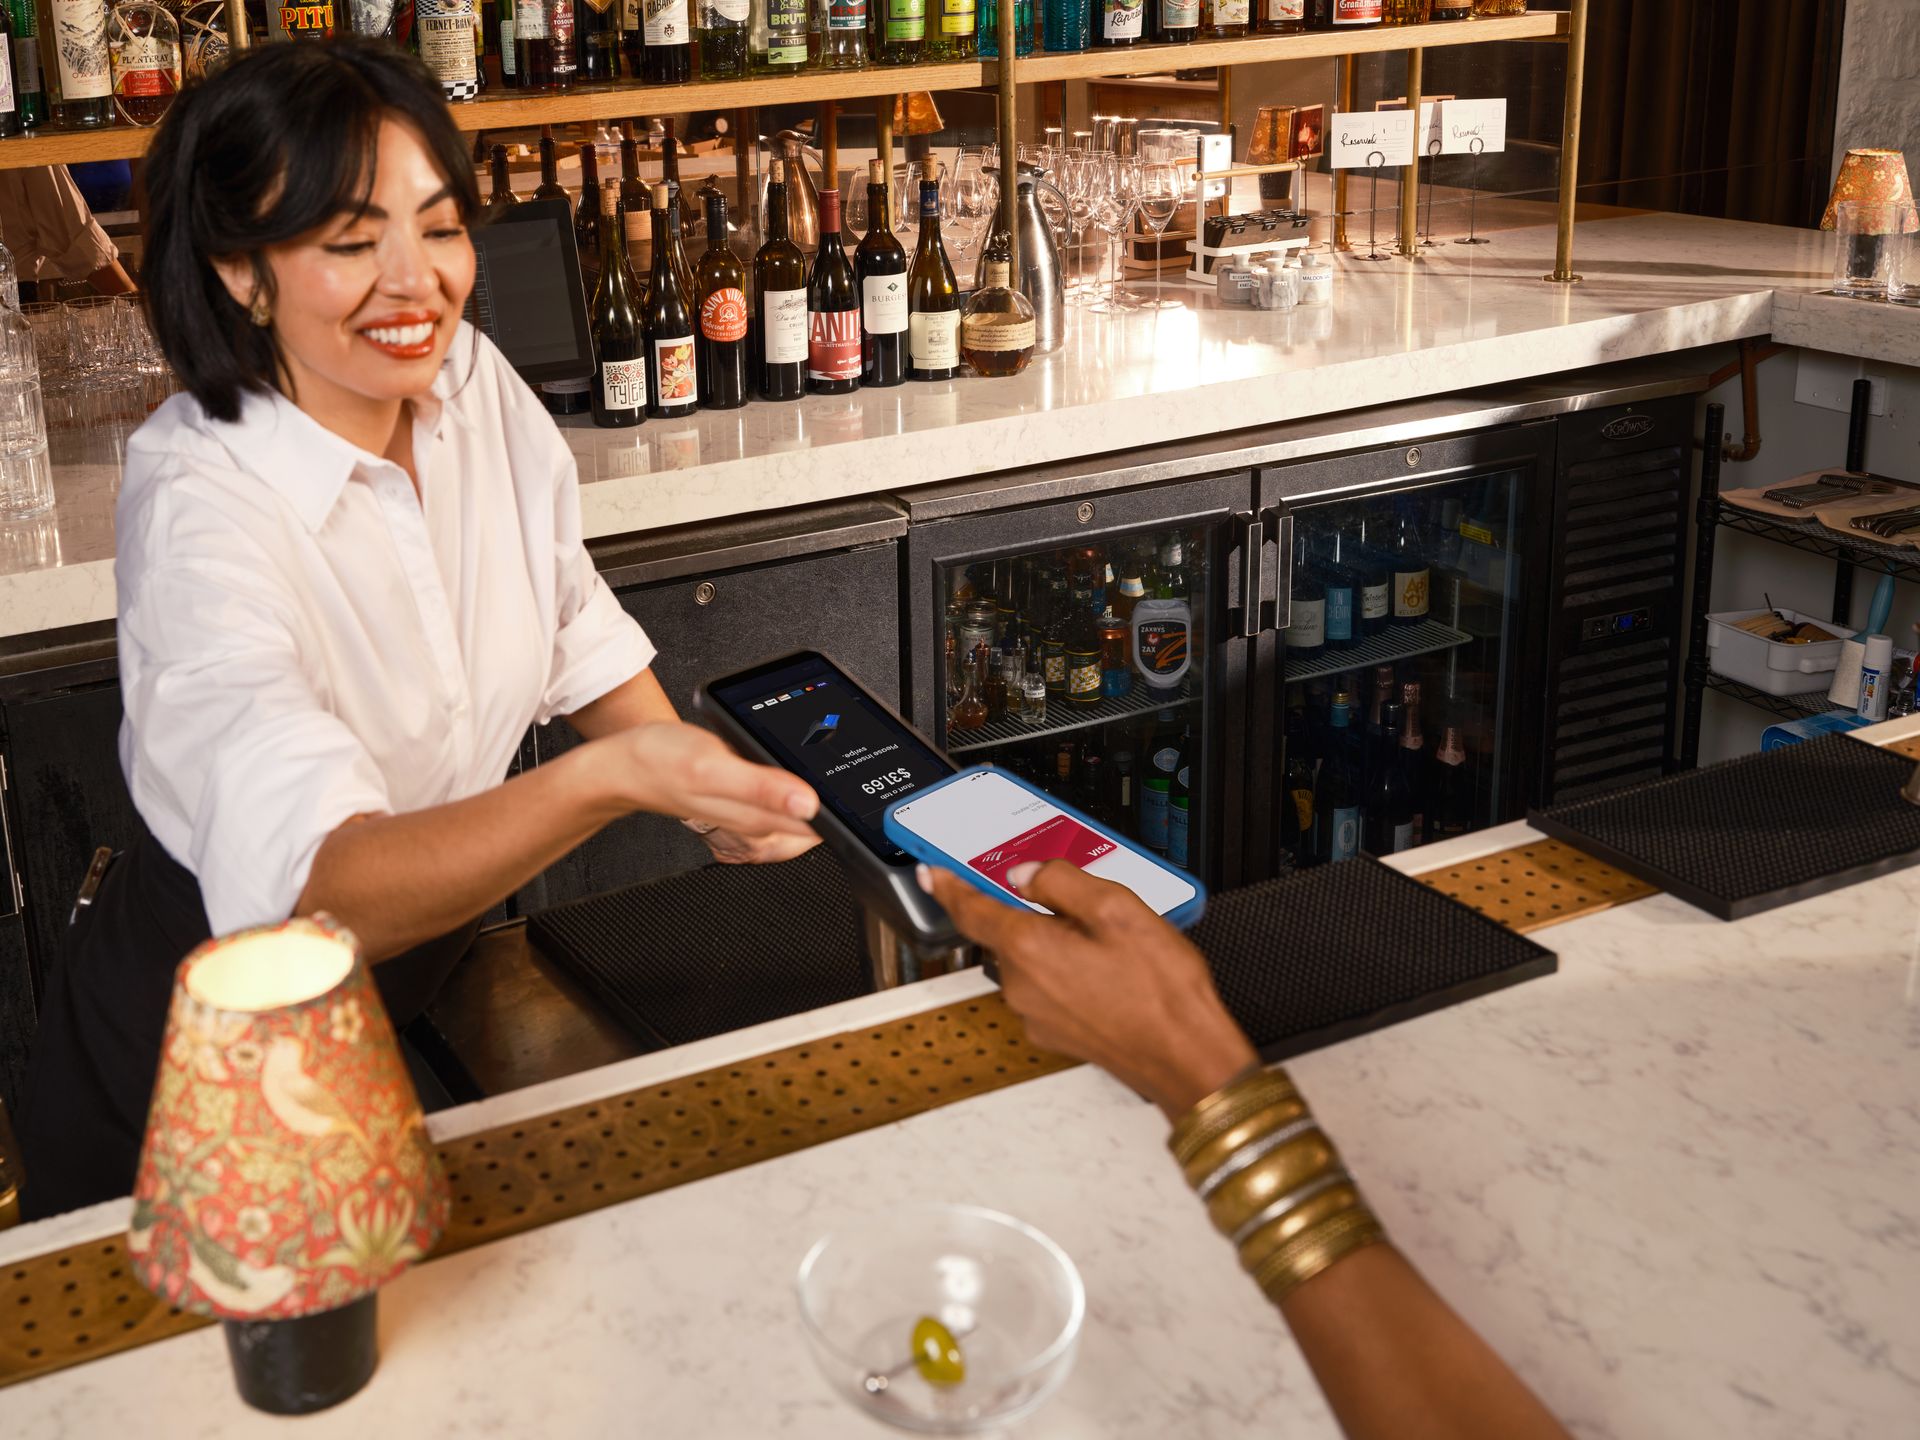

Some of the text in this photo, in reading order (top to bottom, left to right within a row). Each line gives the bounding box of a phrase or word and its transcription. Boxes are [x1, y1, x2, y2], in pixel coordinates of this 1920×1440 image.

[771, 12, 806, 25] BRUTT
[872, 293, 906, 303] BURGES
[703, 292, 724, 318] SAINT
[610, 381, 644, 405] TYLER
[842, 746, 868, 758] swipe.
[873, 743, 899, 756] Please
[848, 753, 874, 766] insert,
[834, 763, 850, 772] tap
[861, 767, 911, 794] $31.69
[898, 782, 915, 792] Start
[880, 791, 893, 800] tab
[1088, 843, 1113, 857] VISA
